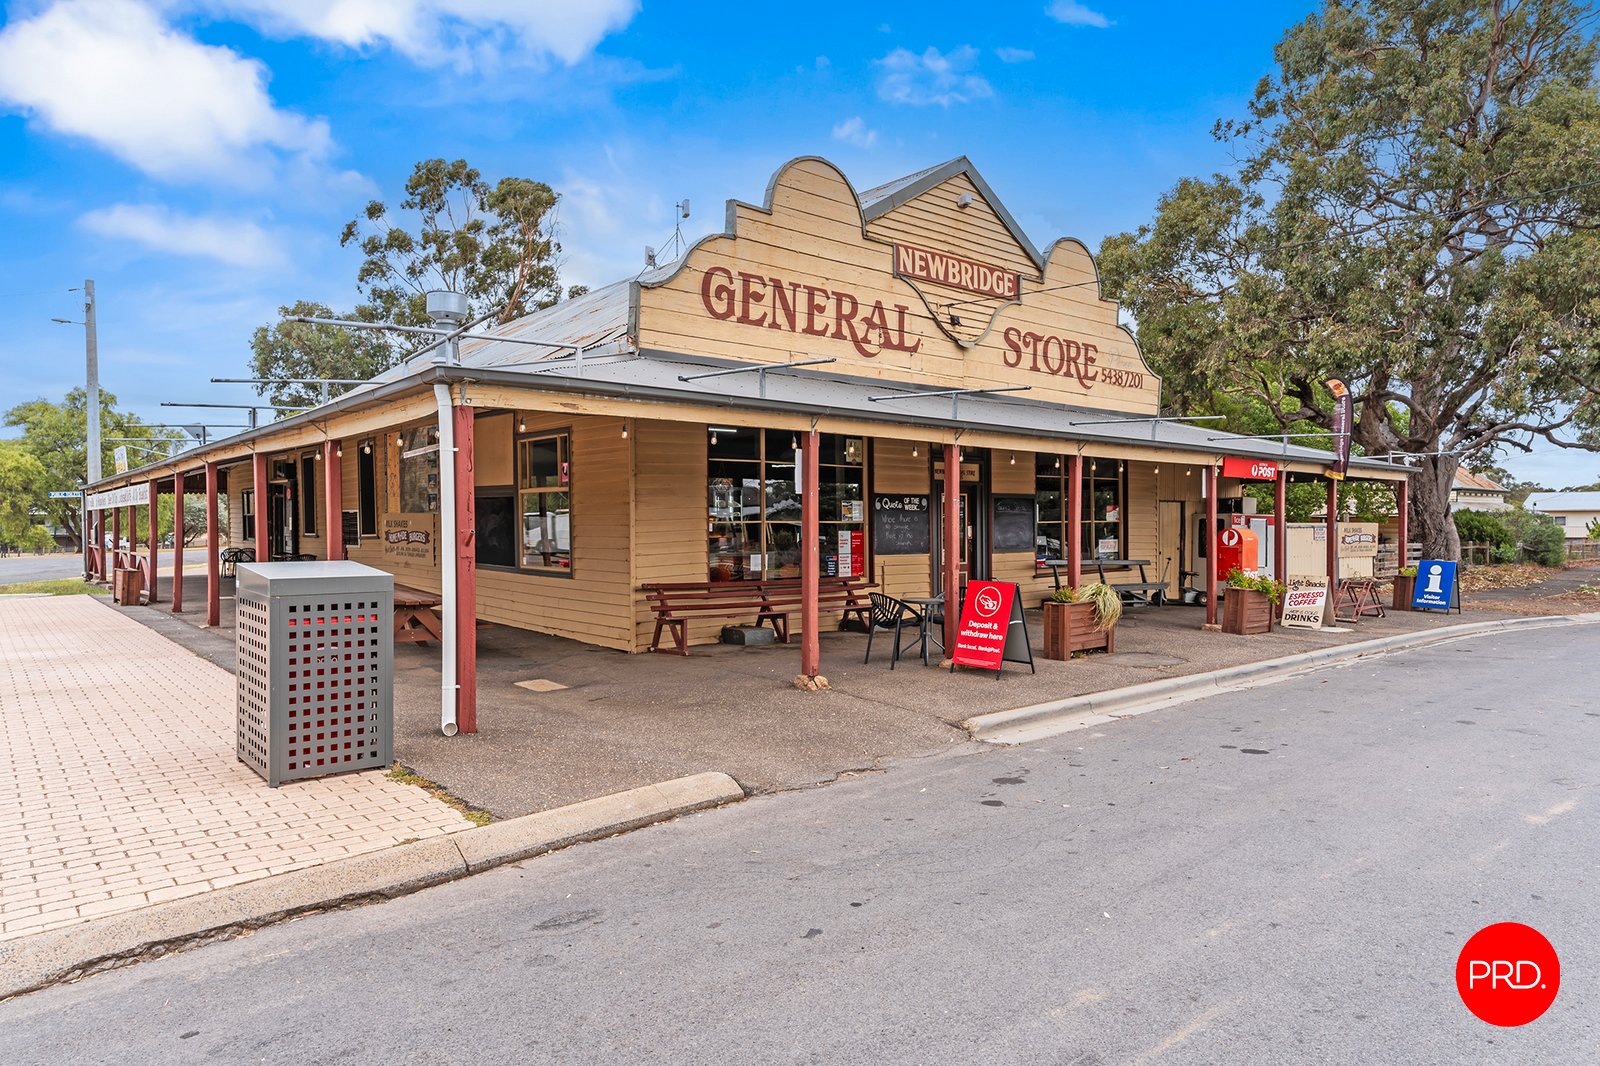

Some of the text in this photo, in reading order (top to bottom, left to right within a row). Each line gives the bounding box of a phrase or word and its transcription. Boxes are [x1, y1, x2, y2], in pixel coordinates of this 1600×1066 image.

[898, 246, 1015, 297] NEWBRIDGE
[701, 266, 921, 358] GENERAL
[1003, 326, 1099, 390] STORE
[1258, 467, 1275, 478] POST
[1289, 579, 1326, 591] Light Snacks
[1289, 591, 1325, 600] ESPRESSO
[1288, 599, 1317, 607] COFFEE
[1416, 598, 1446, 606] Information
[1284, 613, 1320, 623] DRINKS
[968, 620, 992, 630] Deposit
[960, 630, 1003, 640] withdraw here
